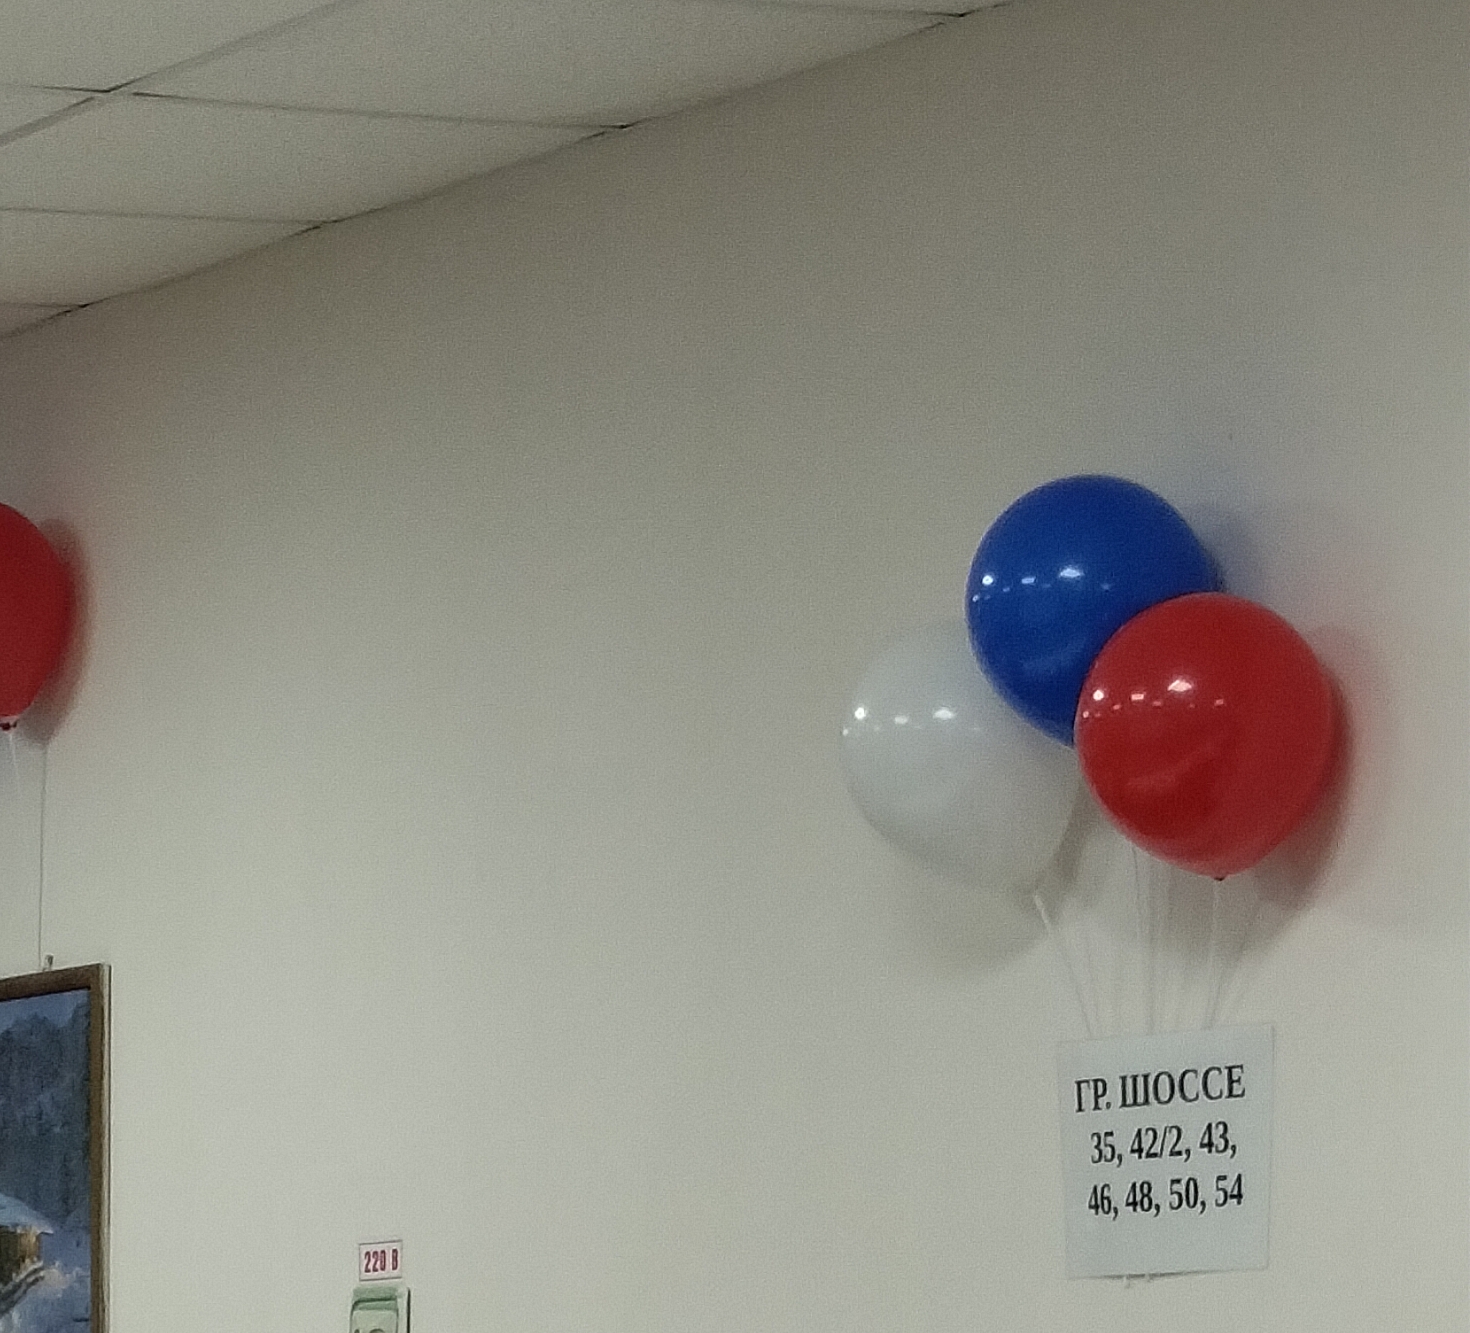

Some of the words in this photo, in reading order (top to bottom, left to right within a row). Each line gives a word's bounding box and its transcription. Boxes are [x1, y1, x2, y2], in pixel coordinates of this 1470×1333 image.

[1074, 1077, 1112, 1113] ГР.
[1118, 1064, 1246, 1109] ШОССЕ
[1090, 1130, 1123, 1168] 35,
[1129, 1124, 1192, 1163] 42/2,
[1199, 1120, 1238, 1159] 43,
[1087, 1183, 1119, 1221] 46,
[1125, 1180, 1161, 1218] 48,
[1169, 1176, 1206, 1215] 50,
[1214, 1172, 1244, 1208] 54
[364, 1250, 387, 1274] 220
